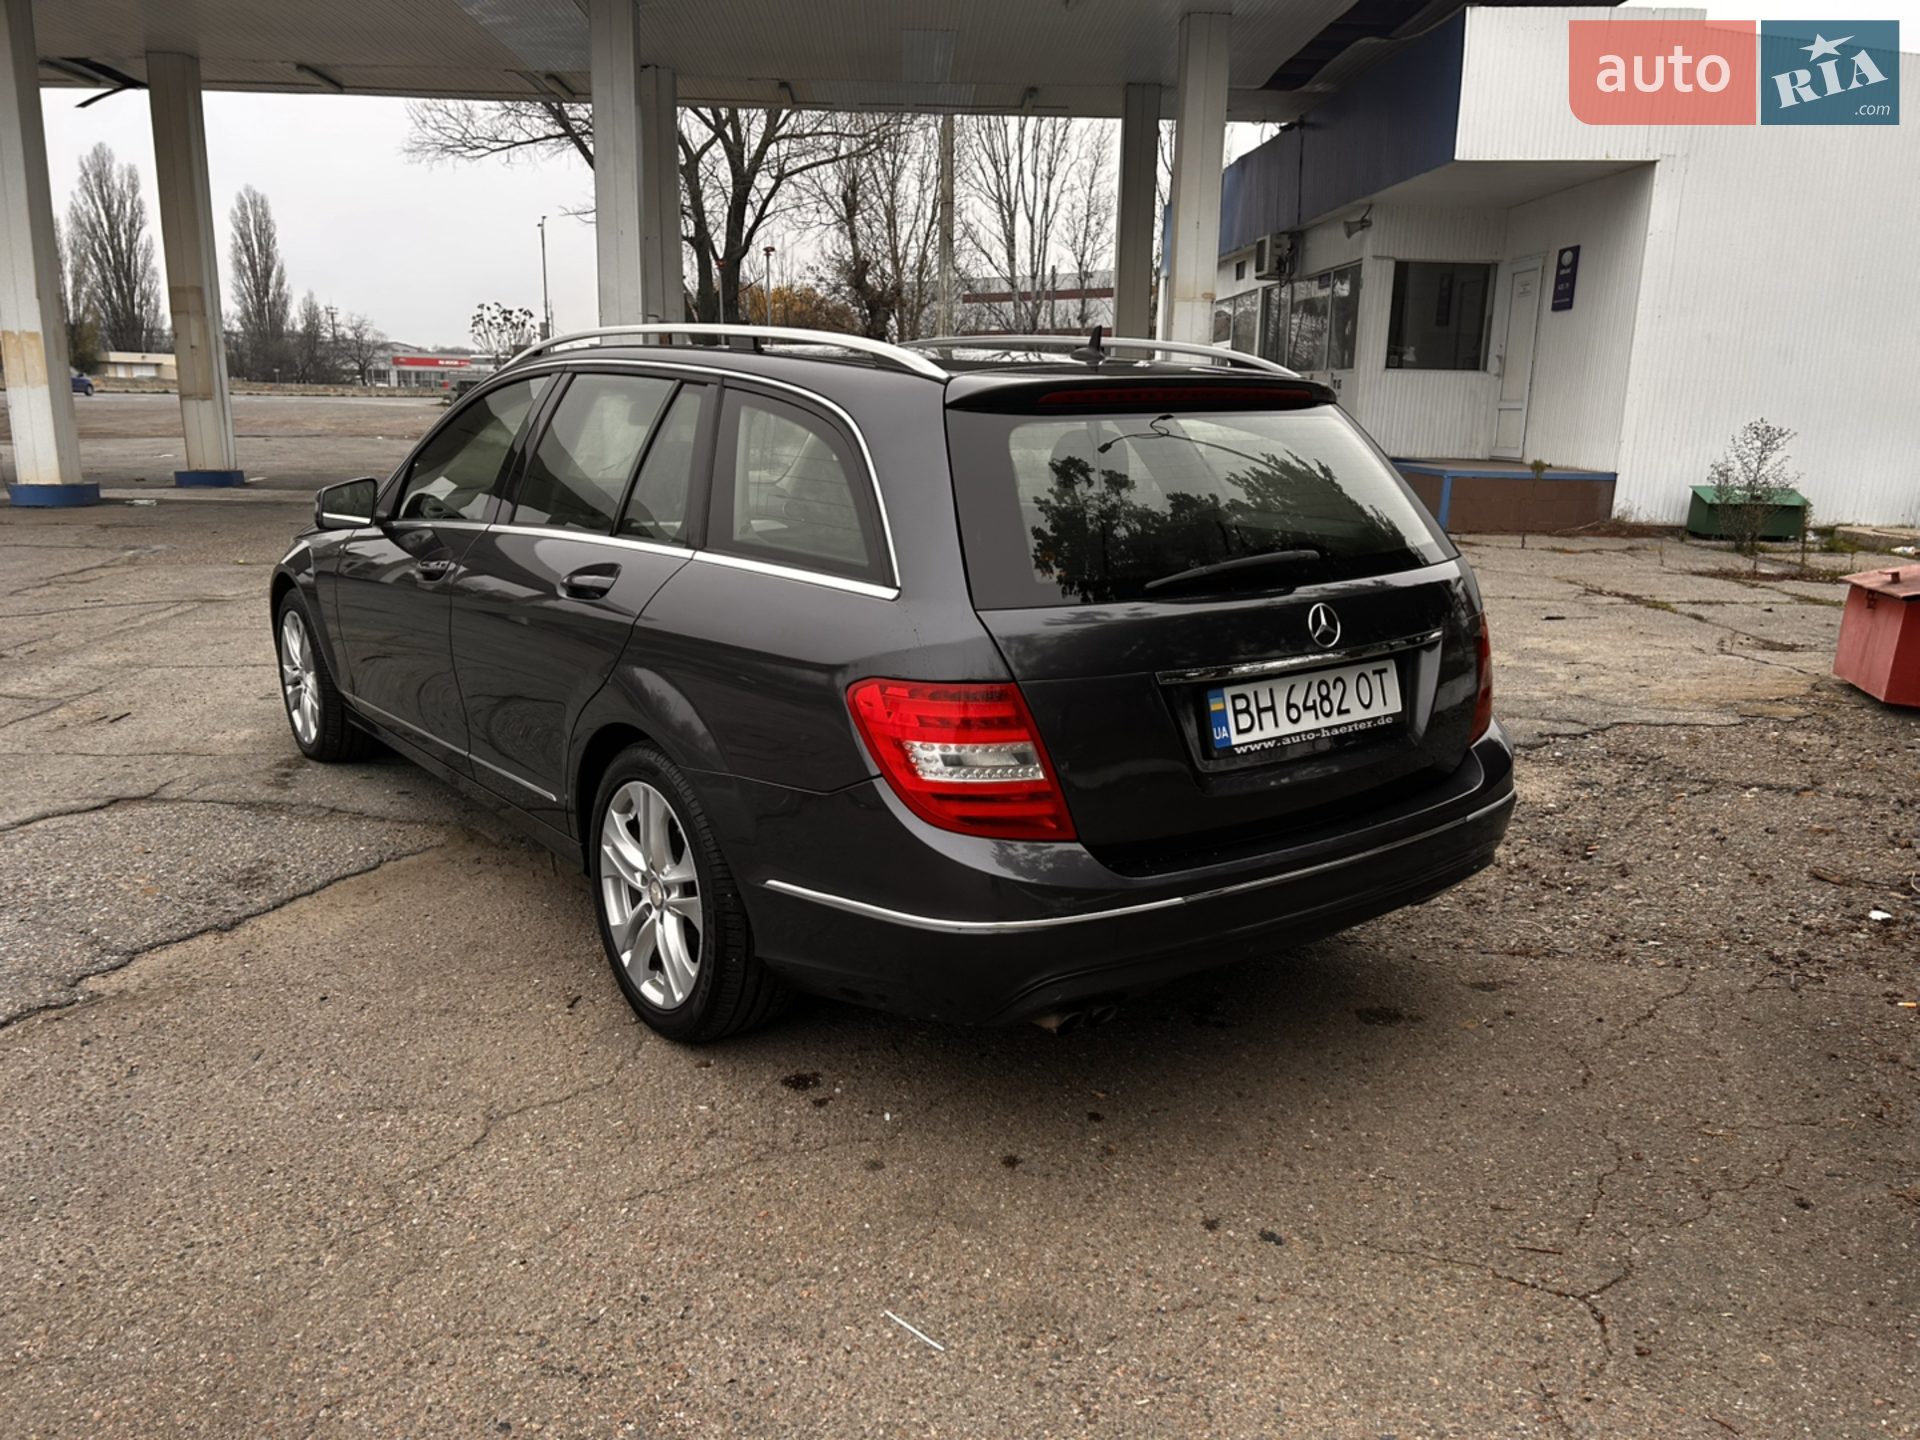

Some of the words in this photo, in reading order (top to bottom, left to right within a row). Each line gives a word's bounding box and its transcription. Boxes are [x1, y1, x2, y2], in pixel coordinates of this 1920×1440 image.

[1230, 687, 1279, 736] BH
[1284, 676, 1351, 725] 6482
[1355, 667, 1389, 710] OT
[1213, 725, 1229, 740] UA
[1233, 715, 1394, 754] www.auto-haerter.de
